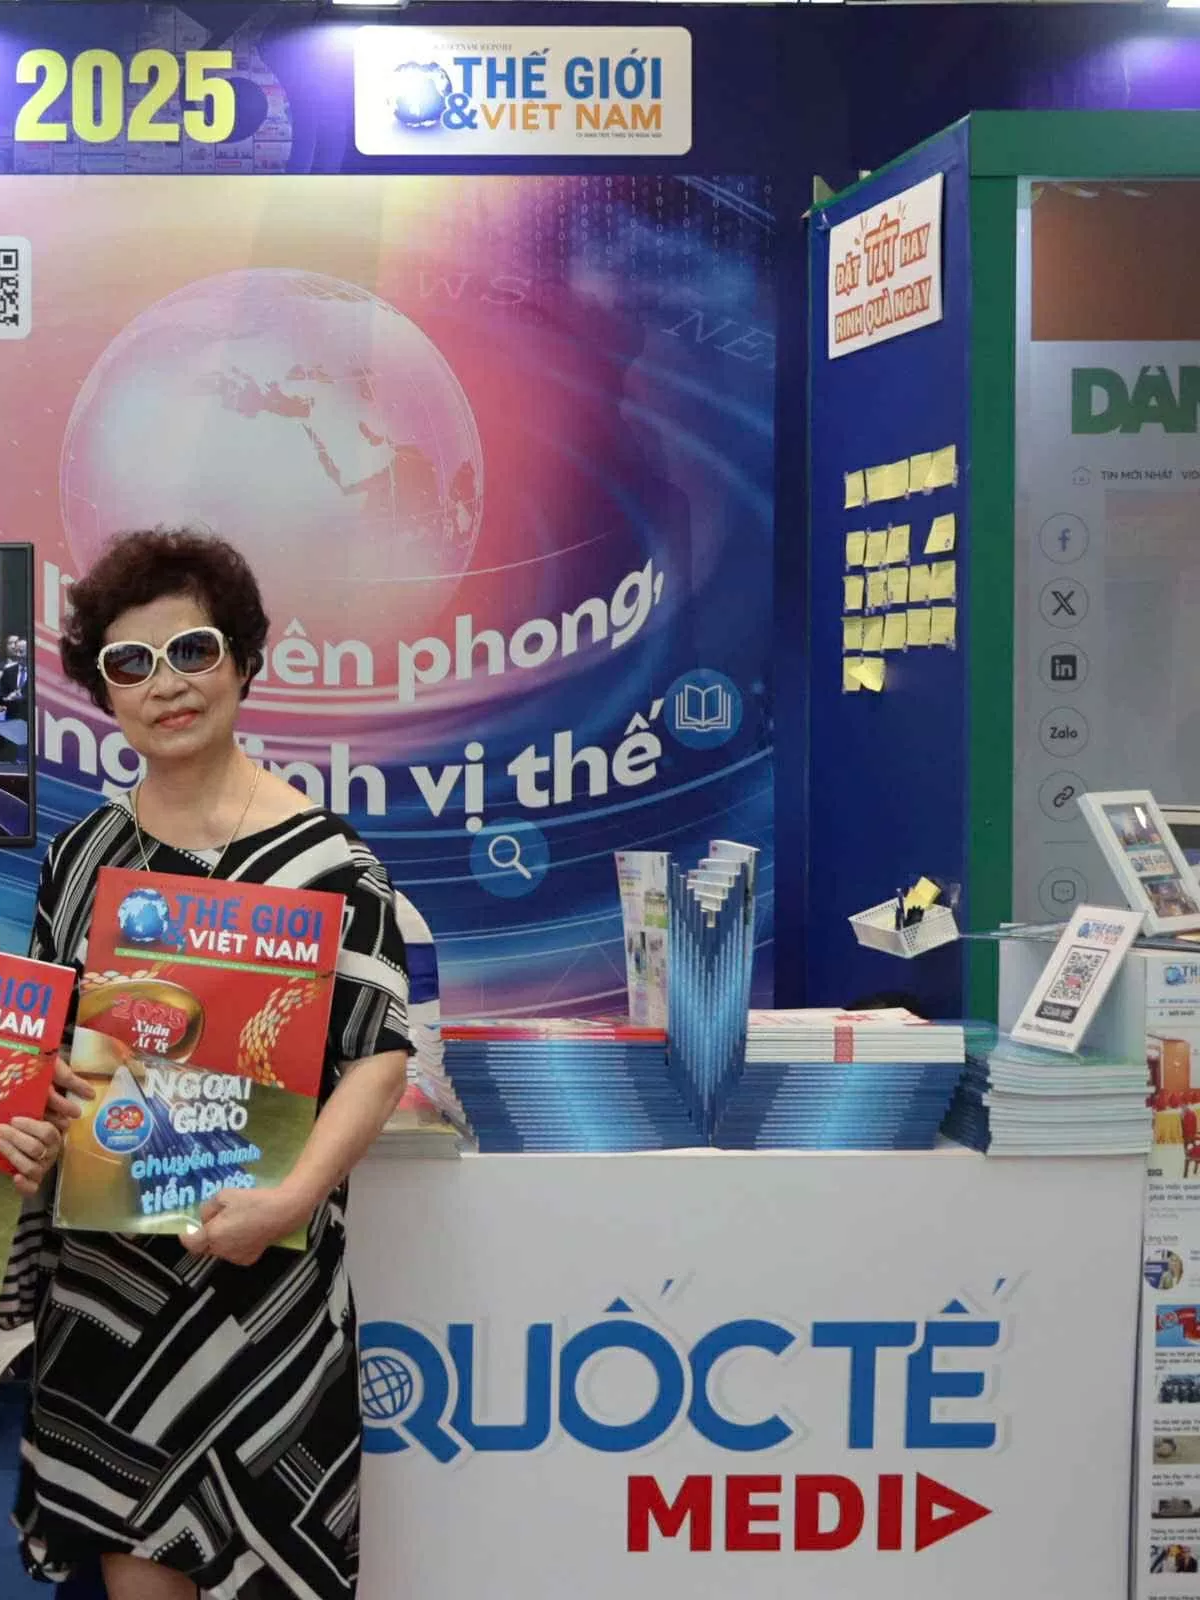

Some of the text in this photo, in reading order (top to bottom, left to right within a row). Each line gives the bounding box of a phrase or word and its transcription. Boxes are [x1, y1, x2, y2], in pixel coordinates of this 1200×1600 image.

[14, 48, 236, 143] 2025
[453, 47, 663, 100] THẾ GIỚI
[442, 92, 663, 134] & VIỆT NAM
[900, 222, 931, 268] HAY
[863, 287, 893, 336] QUÀ
[893, 275, 932, 322] NGAY
[397, 557, 665, 702] phong,
[1050, 727, 1078, 739] Zalo
[408, 742, 484, 833] vị
[507, 698, 666, 809] thế
[172, 893, 323, 941] THẾ GIỚI
[189, 927, 248, 955] VIỆT
[255, 936, 320, 964] NAM
[811, 1277, 1007, 1449] TẾ
